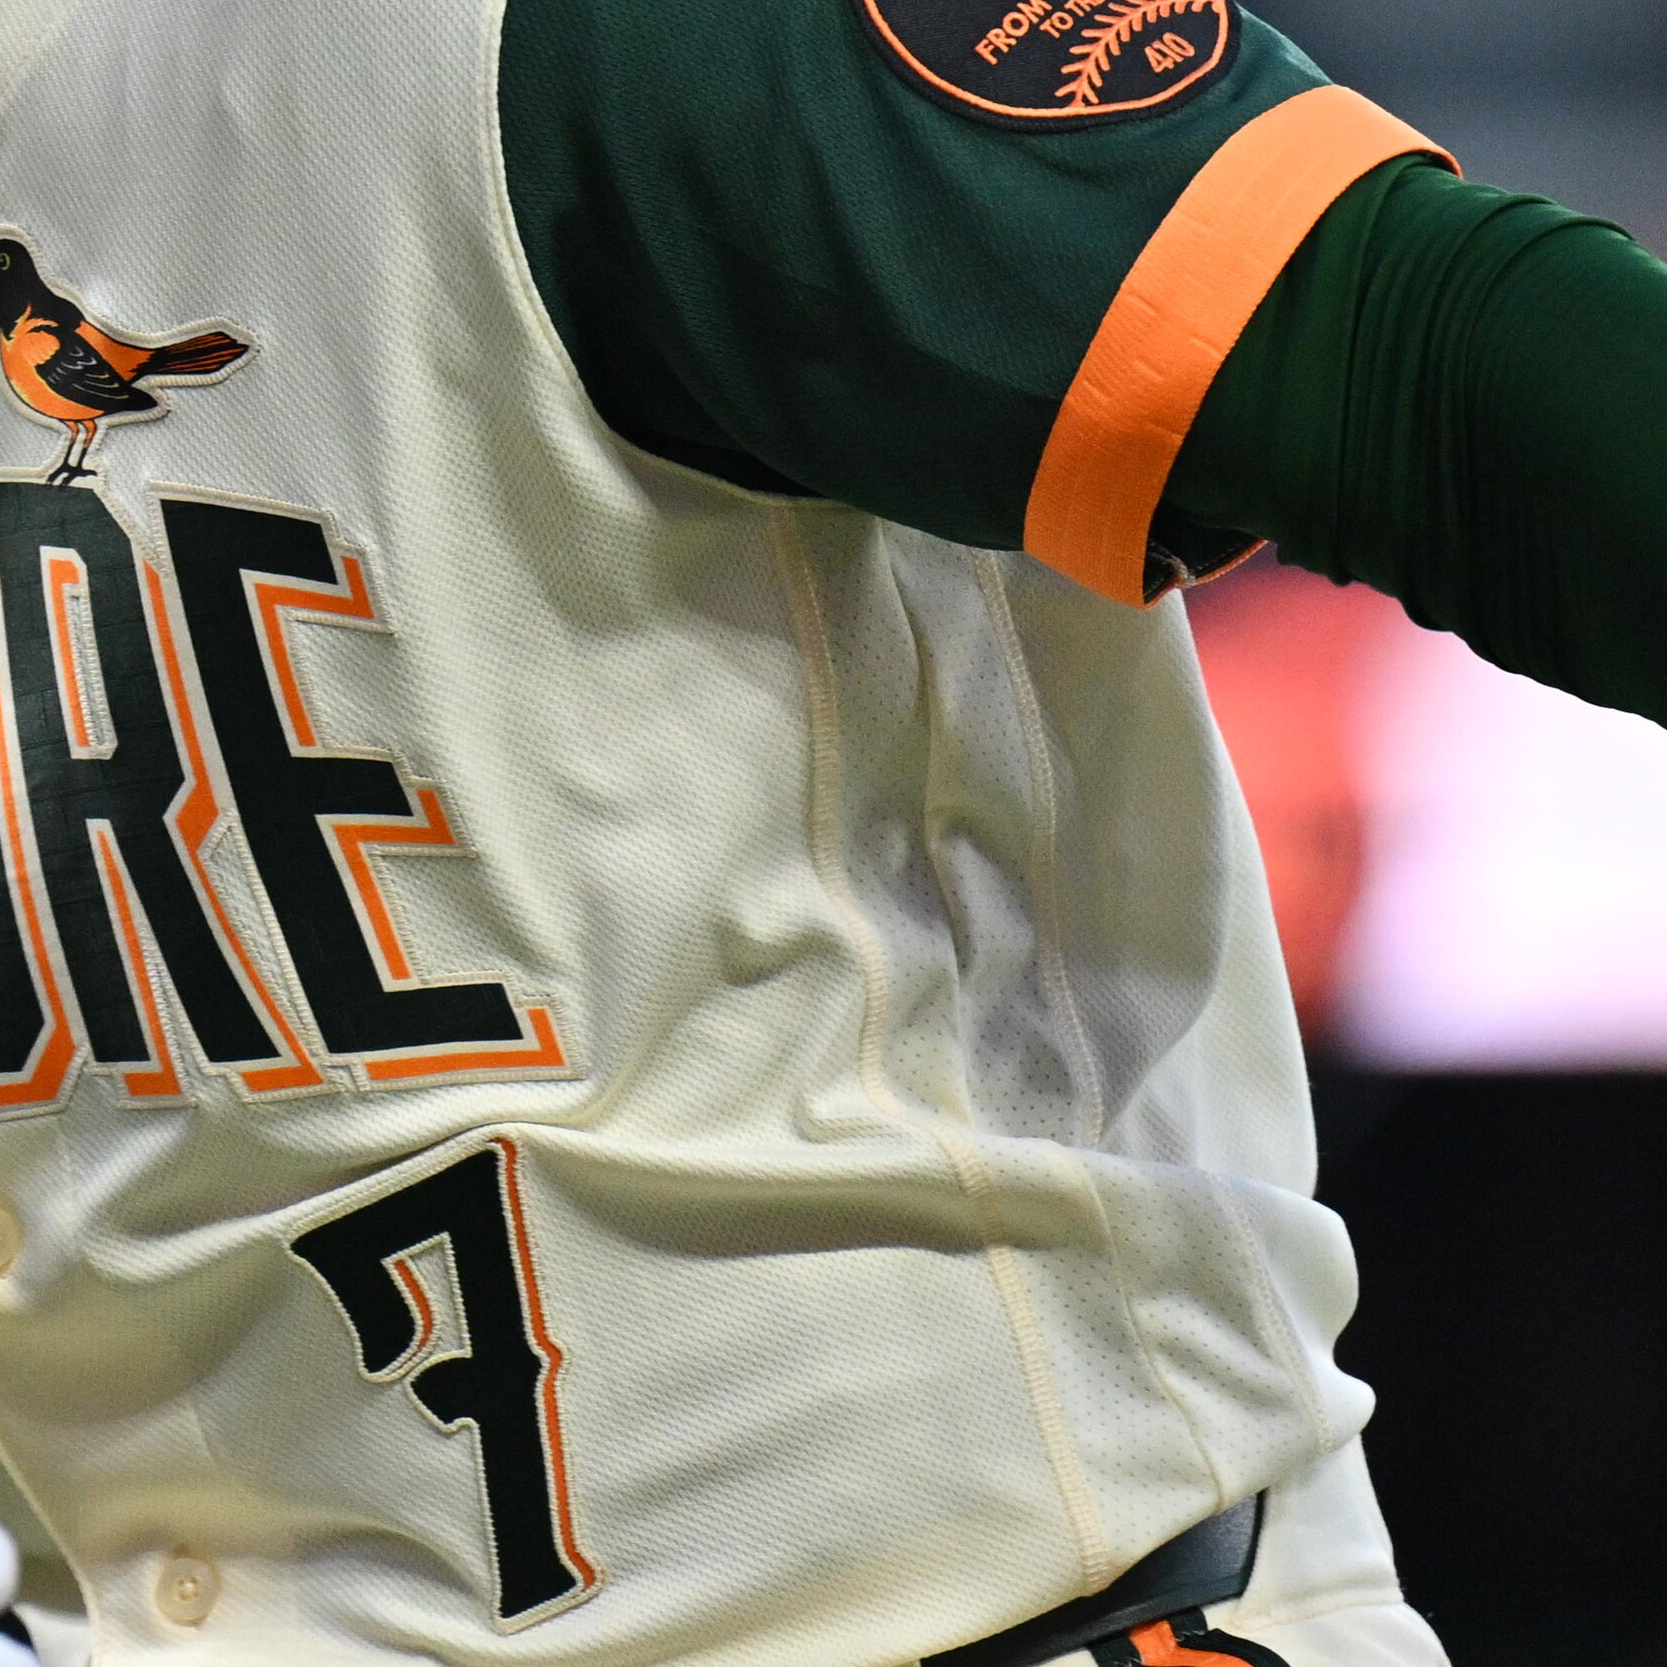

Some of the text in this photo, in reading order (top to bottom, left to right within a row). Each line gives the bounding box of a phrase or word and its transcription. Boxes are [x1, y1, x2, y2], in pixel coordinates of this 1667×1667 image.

[1039, 11, 1074, 38] TO
[1144, 32, 1195, 73] 410
[286, 1136, 601, 1629] 7
